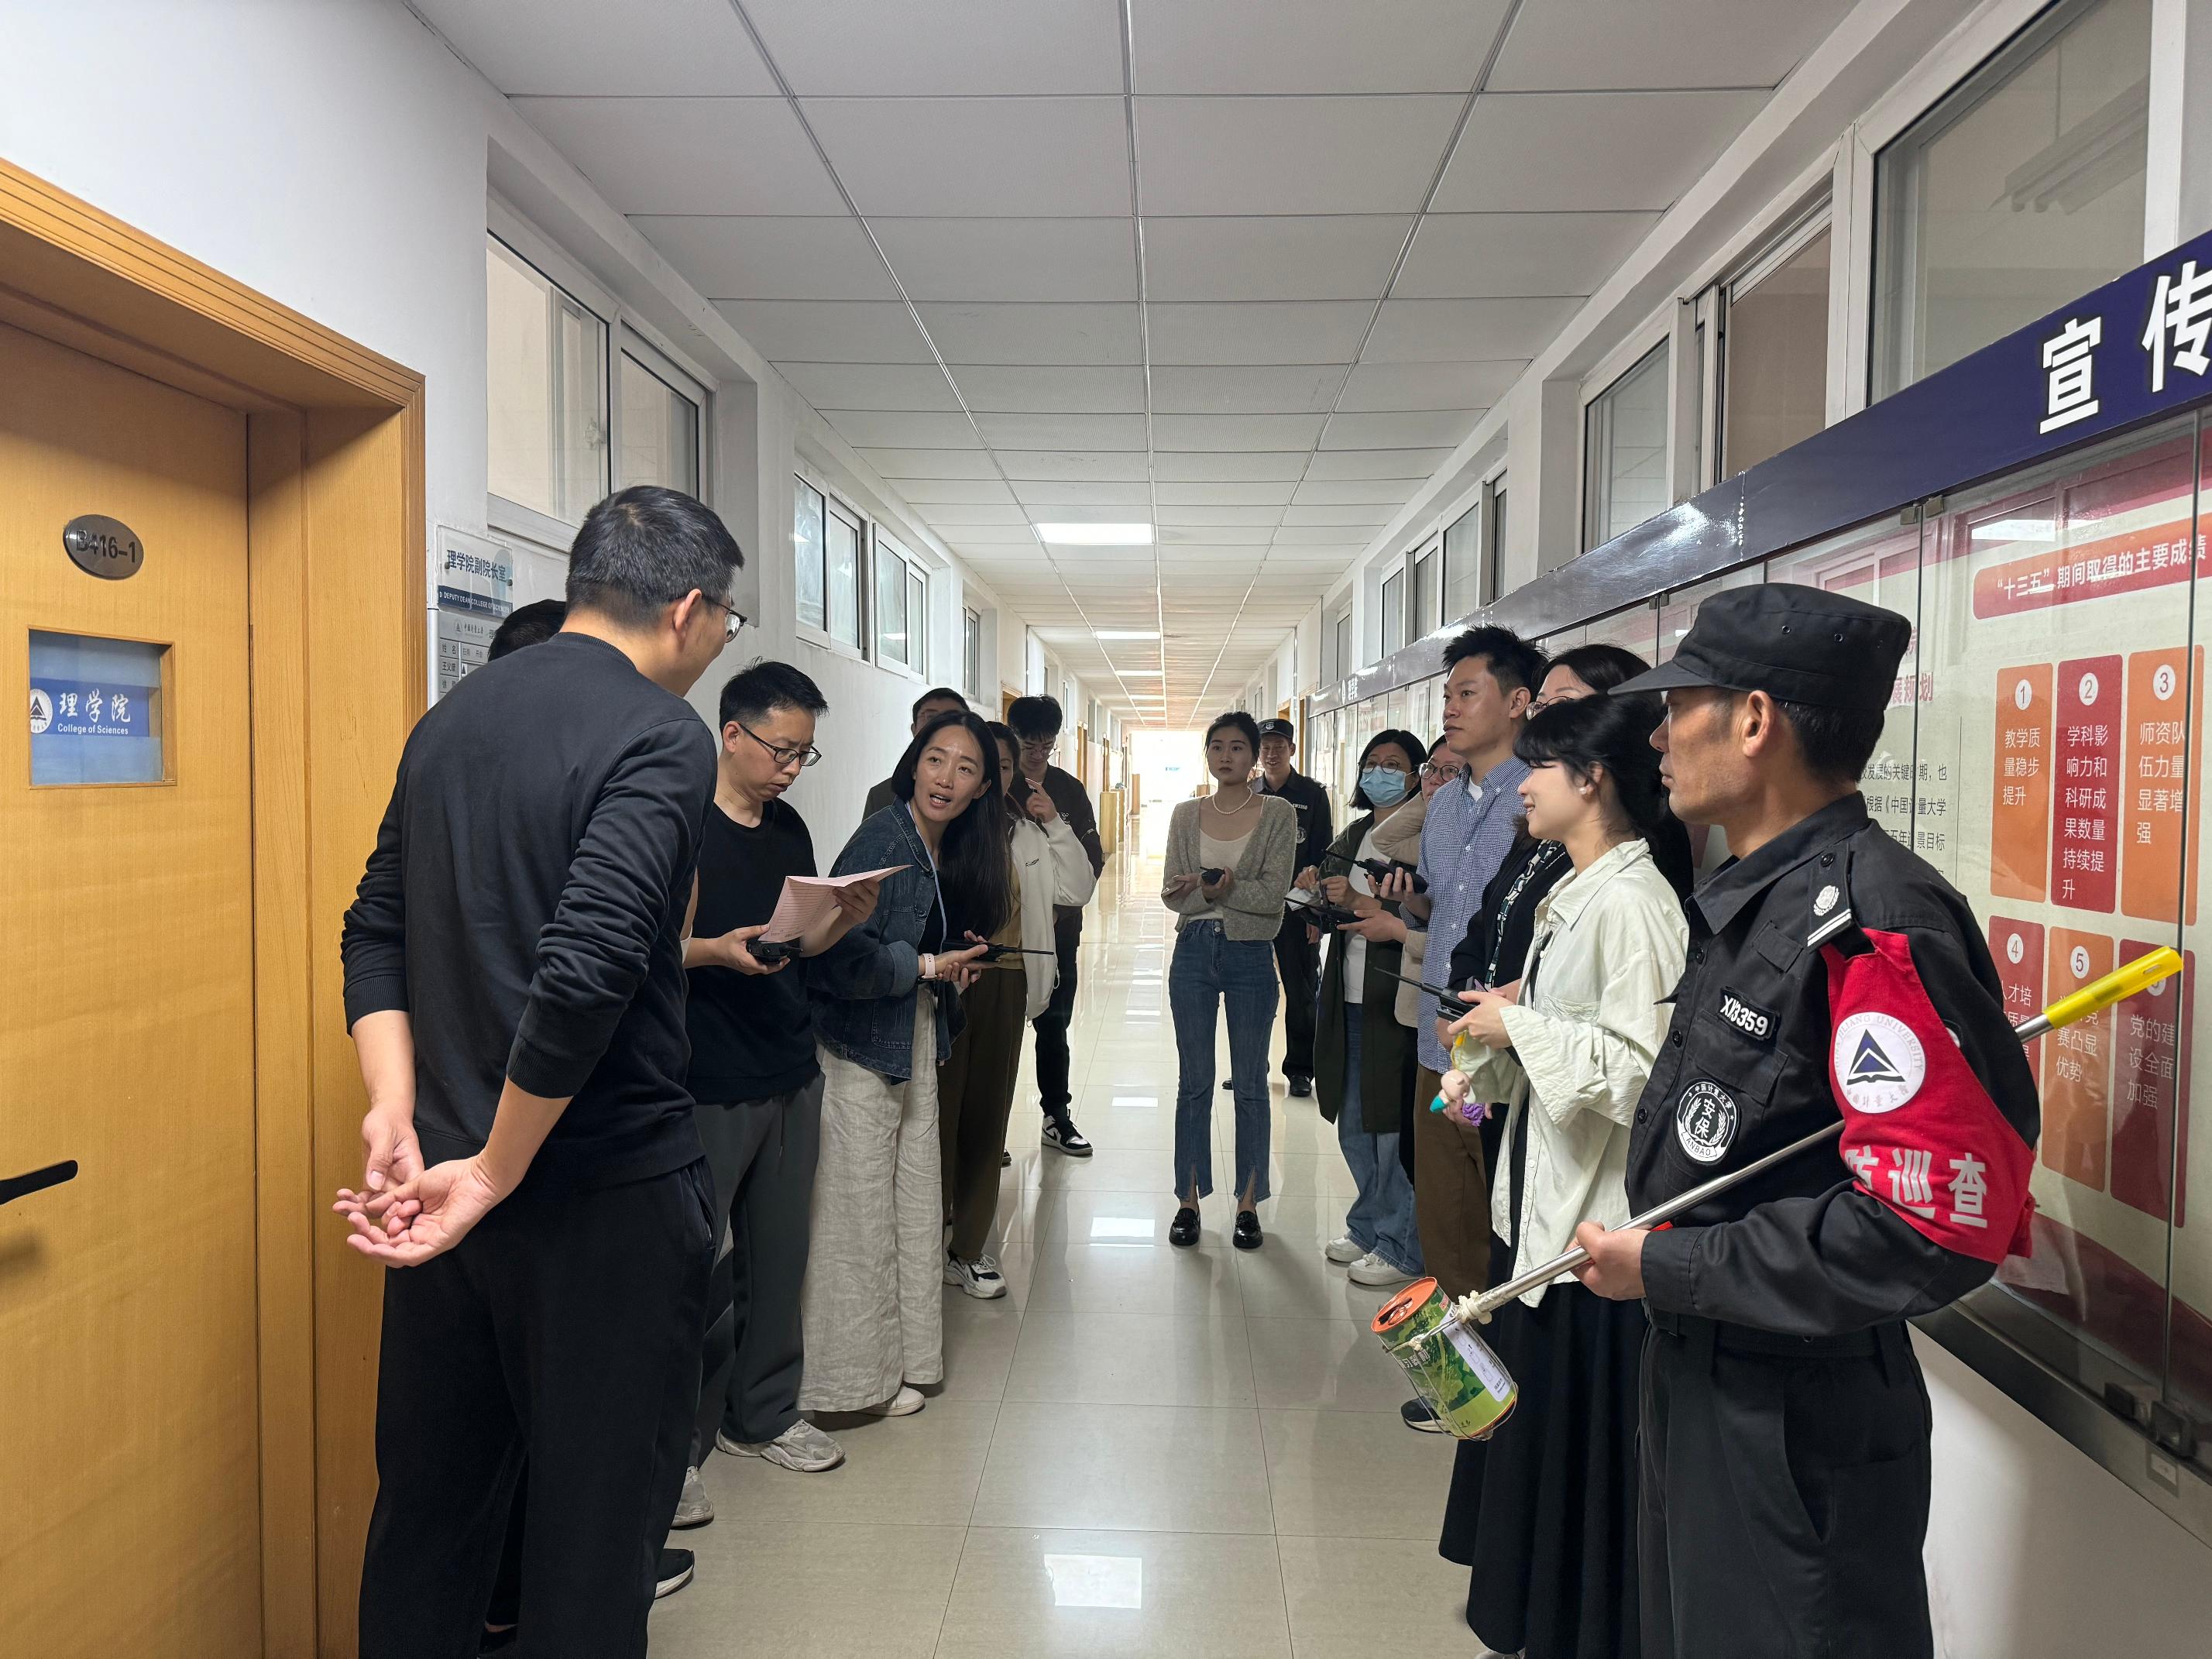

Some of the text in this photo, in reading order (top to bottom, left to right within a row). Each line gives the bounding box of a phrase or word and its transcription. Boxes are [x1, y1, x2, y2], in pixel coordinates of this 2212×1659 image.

[2040, 260, 2212, 434] 宣传
[76, 530, 136, 563] B416-1
[447, 549, 507, 583] 理学院副院长室
[2083, 679, 2093, 699] 2
[2159, 672, 2169, 693] 3
[59, 688, 131, 723] 理学院
[57, 723, 86, 735] College
[88, 725, 95, 733] of
[97, 725, 129, 735] Sciences
[2005, 728, 2040, 748] 教学质
[2067, 724, 2108, 747] 学科影
[2140, 721, 2185, 745] 师资队
[2004, 756, 2040, 777] 量稳步
[2066, 756, 2107, 778] 响力和
[2138, 754, 2185, 778] 伍力量
[1863, 795, 1946, 816] 根据《中国量大学
[2002, 785, 2027, 806] 提升
[2065, 787, 2107, 809] 科研成
[2137, 788, 2183, 812] 显著增
[2064, 818, 2105, 840] 果数量
[2136, 822, 2152, 844] 强
[2063, 847, 2104, 872] 持续提
[2062, 878, 2076, 900] 升
[2011, 939, 2019, 958] 4
[2076, 953, 2084, 972] 5
[2130, 1014, 2176, 1046] 党的建
[1877, 1015, 1923, 1071] UNIVERSITY
[2057, 1027, 2098, 1057] 赛凸显
[2056, 1055, 2083, 1083] 优势
[2128, 1046, 2175, 1080] 设全面
[1695, 1084, 1733, 1109] 中国计量大学
[2127, 1080, 2159, 1110] 加强
[1695, 1098, 1716, 1139] 安保
[1686, 1138, 1711, 1156] ANBAO
